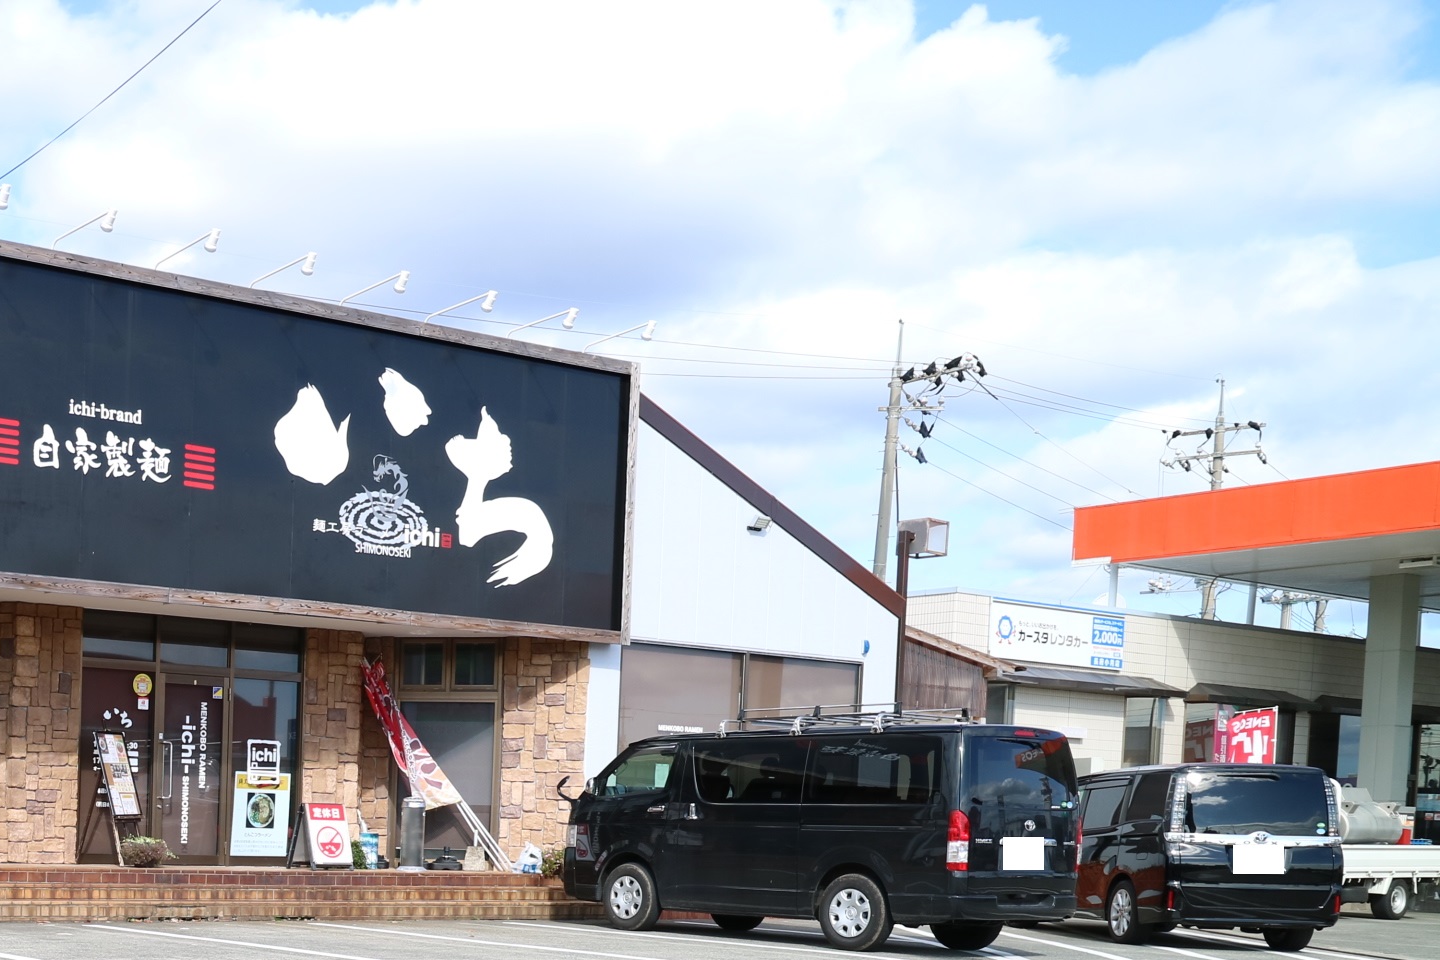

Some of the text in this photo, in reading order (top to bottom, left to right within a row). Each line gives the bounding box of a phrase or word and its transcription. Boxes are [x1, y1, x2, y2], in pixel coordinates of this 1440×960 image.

[69, 399, 143, 425] ichi-brand
[33, 424, 172, 483] 自家製麺
[274, 367, 554, 588] いち
[404, 523, 440, 547] ichi
[354, 542, 411, 558] SHIMONOSEKI
[1018, 630, 1088, 647] カースタレンタカー
[198, 702, 208, 789] MENKOBO RAMEN
[251, 747, 277, 762] ichi
[180, 776, 189, 844] SHIMONOSEKI
[312, 807, 340, 818] 定休日
